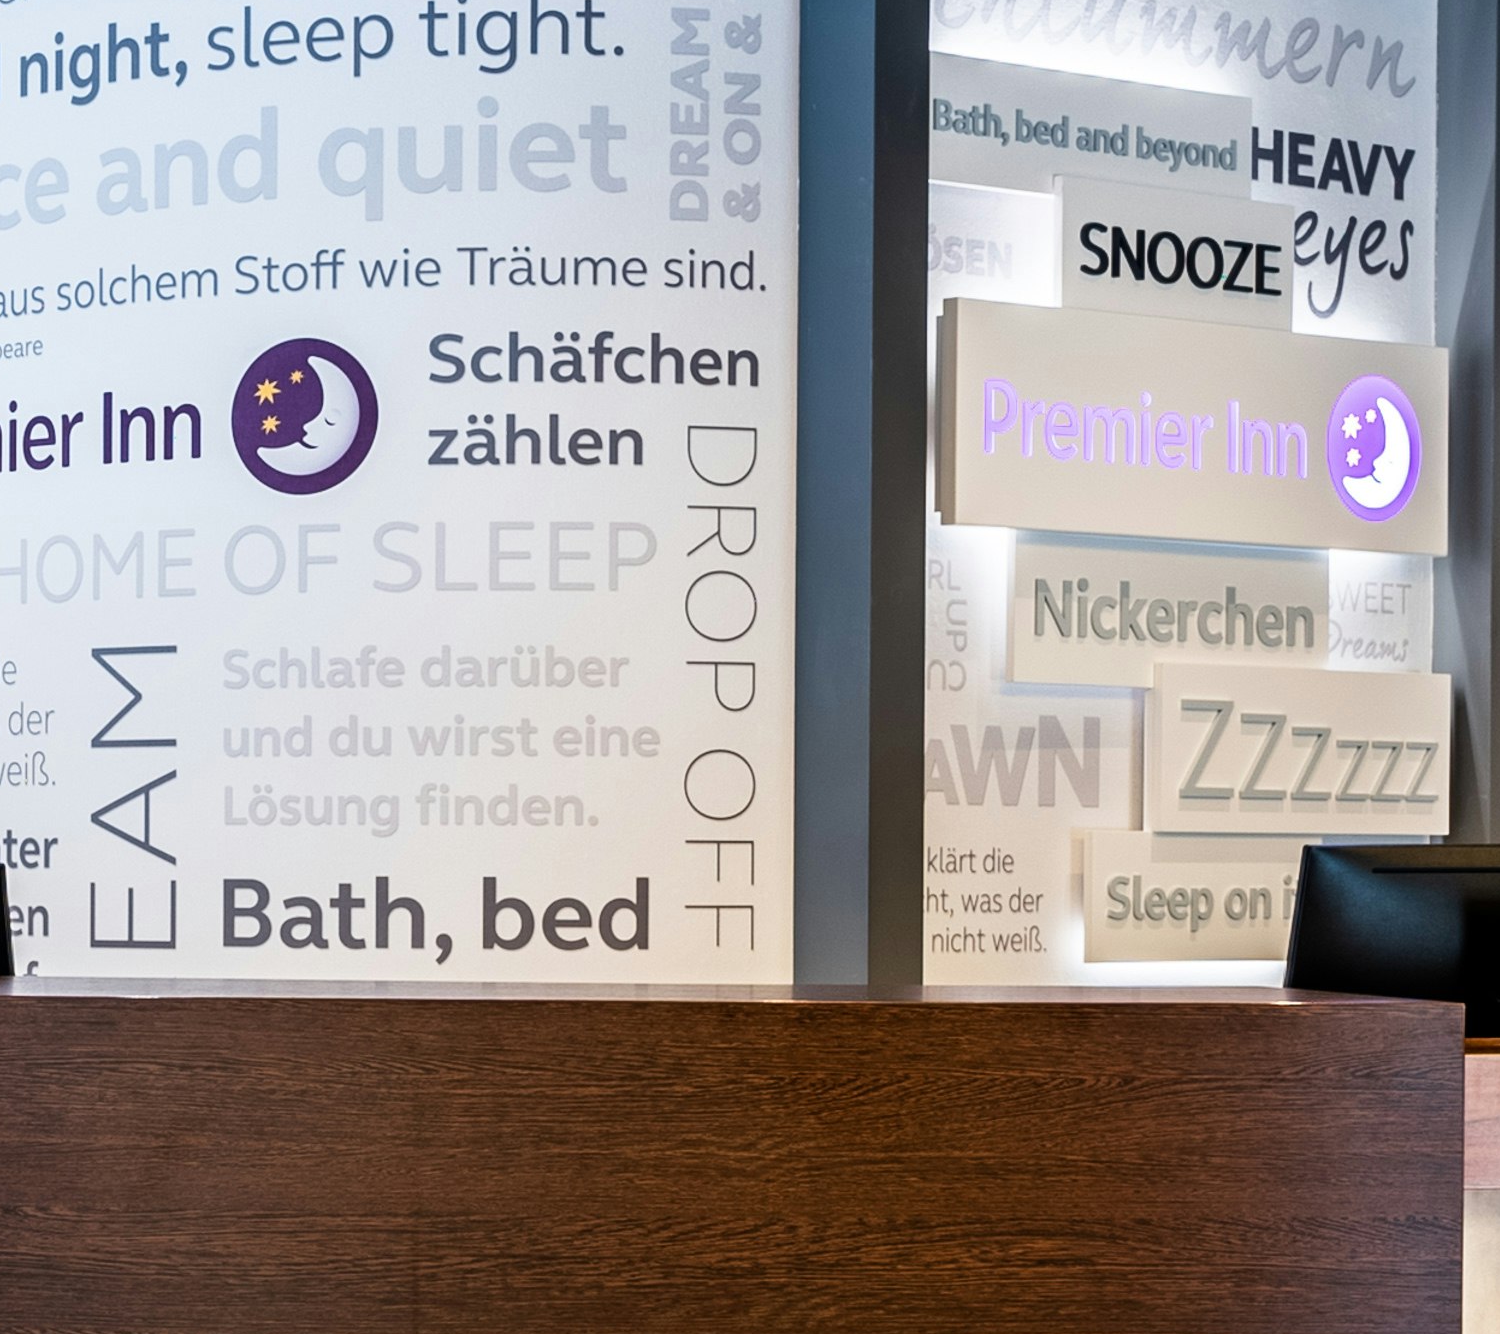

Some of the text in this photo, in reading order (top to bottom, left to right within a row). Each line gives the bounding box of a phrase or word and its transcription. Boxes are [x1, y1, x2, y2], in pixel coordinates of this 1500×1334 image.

[19, 22, 188, 105] night,
[207, 6, 394, 77] sleep
[724, 13, 762, 55] &
[669, 7, 711, 222] DREAM
[723, 71, 762, 166] ON
[932, 98, 1237, 173] Bath, bed and beyond
[96, 105, 278, 216] and
[318, 95, 628, 222] quiet
[1251, 126, 1416, 201] HEAVY
[723, 181, 761, 223] &
[56, 264, 218, 311] solchem
[234, 249, 346, 295] Stoff
[360, 248, 441, 290] wie
[457, 246, 647, 287] Träume
[663, 249, 767, 293] sind.
[1079, 222, 1282, 297] SNOOZE
[1292, 210, 1415, 318] eyes
[428, 331, 760, 387] Schäfchen
[103, 391, 201, 464] Inn
[428, 413, 644, 466] zählen
[983, 379, 1308, 480] Premier Inn
[224, 523, 341, 596] OF
[372, 521, 658, 593] SLEEP
[1034, 578, 1315, 649] Nickerchen
[1329, 581, 1412, 615] WEET
[223, 645, 630, 690] Schlafe darüber
[684, 424, 758, 952] DROP OFF
[8, 701, 55, 736] der
[223, 715, 661, 758] und du wirst eine
[223, 783, 599, 838] Lösung finden.
[927, 846, 1015, 874] klärt die
[221, 876, 650, 965] Bath, bed
[961, 893, 1003, 913] was
[1009, 886, 1044, 913] der
[1107, 875, 1214, 933] Sleep
[1224, 887, 1272, 921] on
[932, 925, 1047, 953] nicht weiß.
